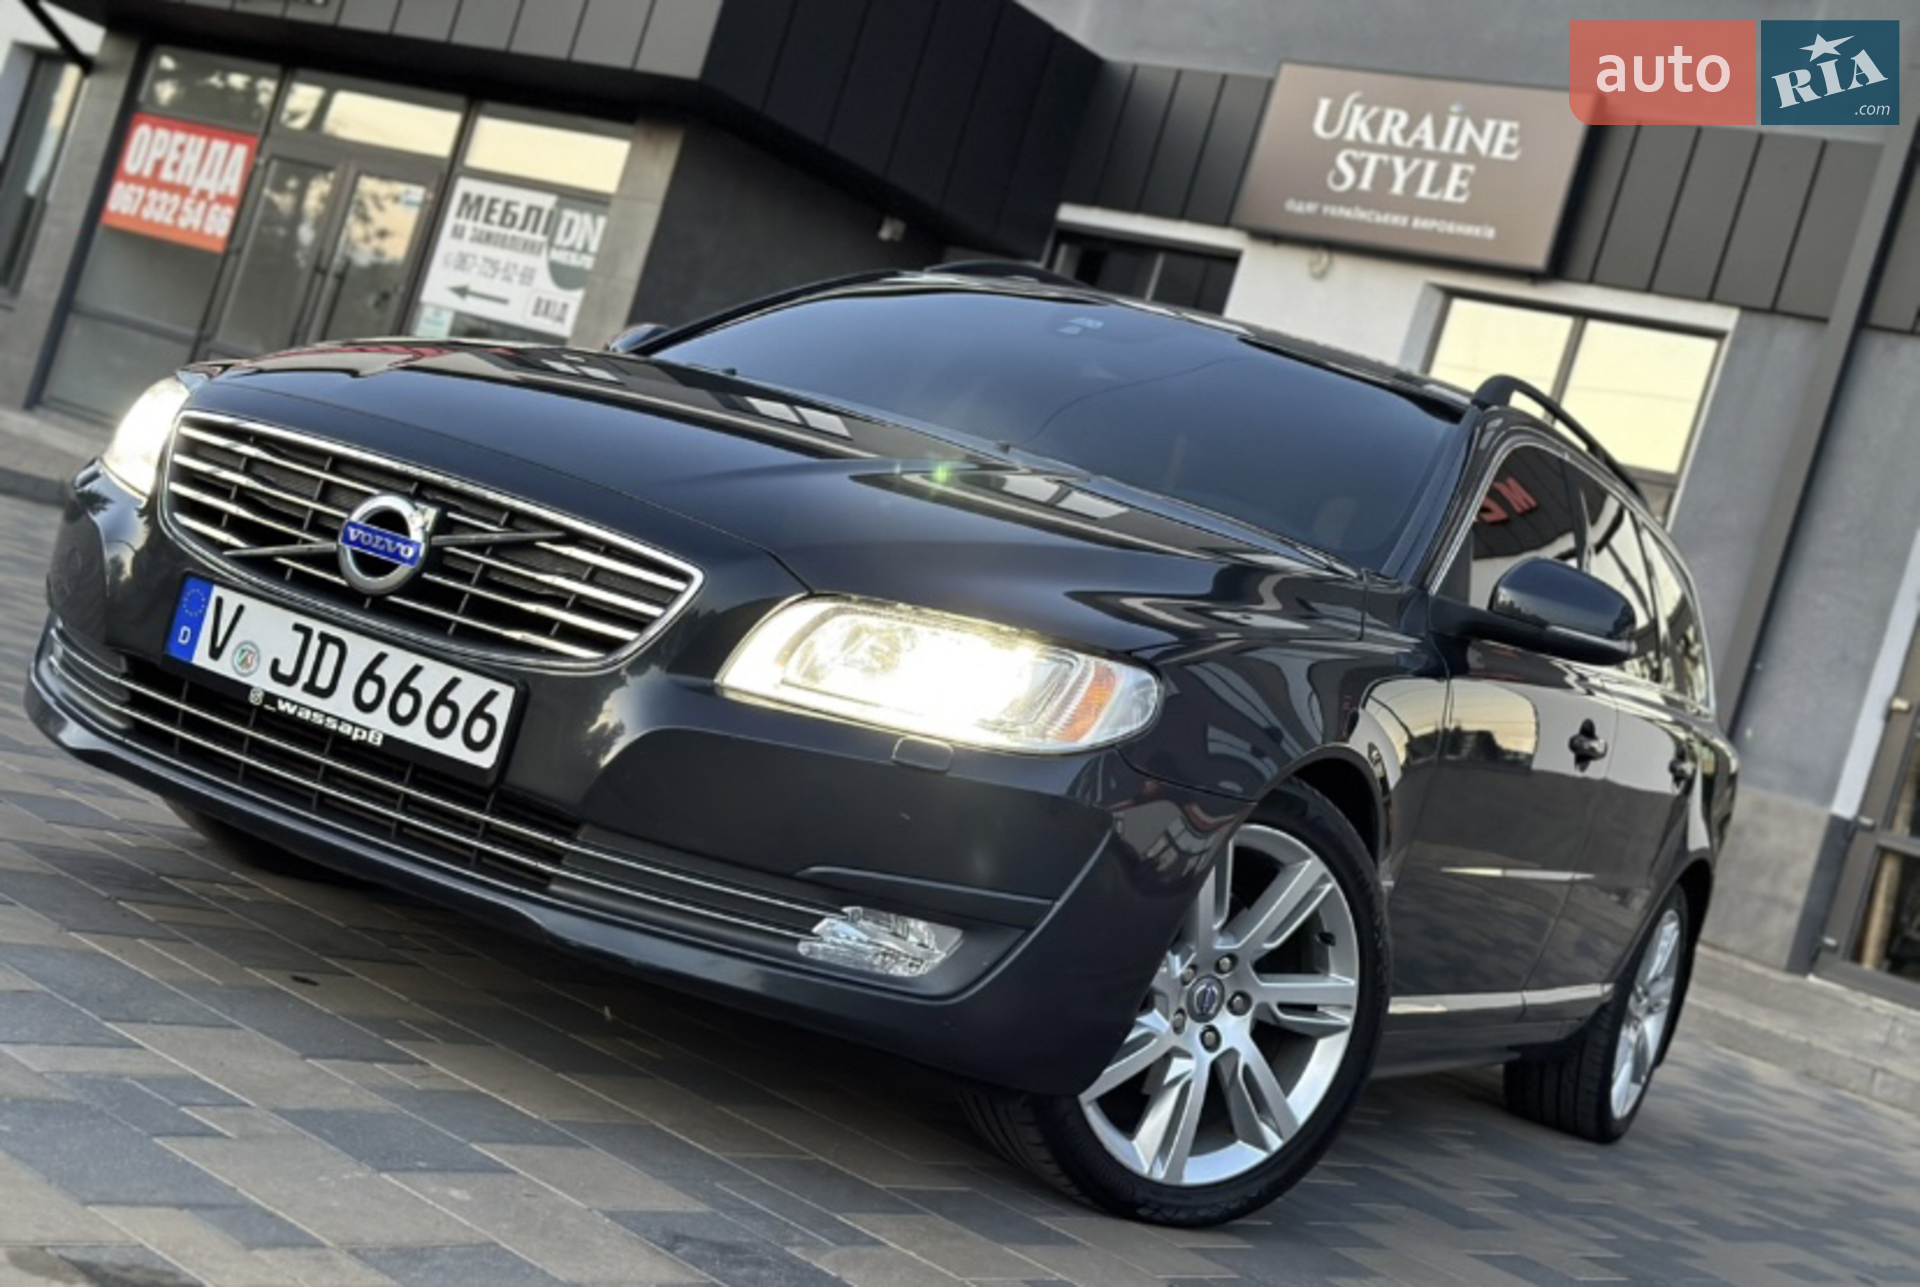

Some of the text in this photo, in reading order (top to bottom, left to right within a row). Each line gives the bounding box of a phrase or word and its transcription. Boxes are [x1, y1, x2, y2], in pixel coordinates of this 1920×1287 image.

[1313, 91, 1521, 161] UKRAINE
[125, 123, 248, 200] ОРЕНДА
[1327, 148, 1476, 204] STYLE
[554, 207, 607, 253] DN
[347, 526, 414, 560] VOLVO
[177, 625, 191, 645] D
[208, 596, 500, 752] V JD 6666
